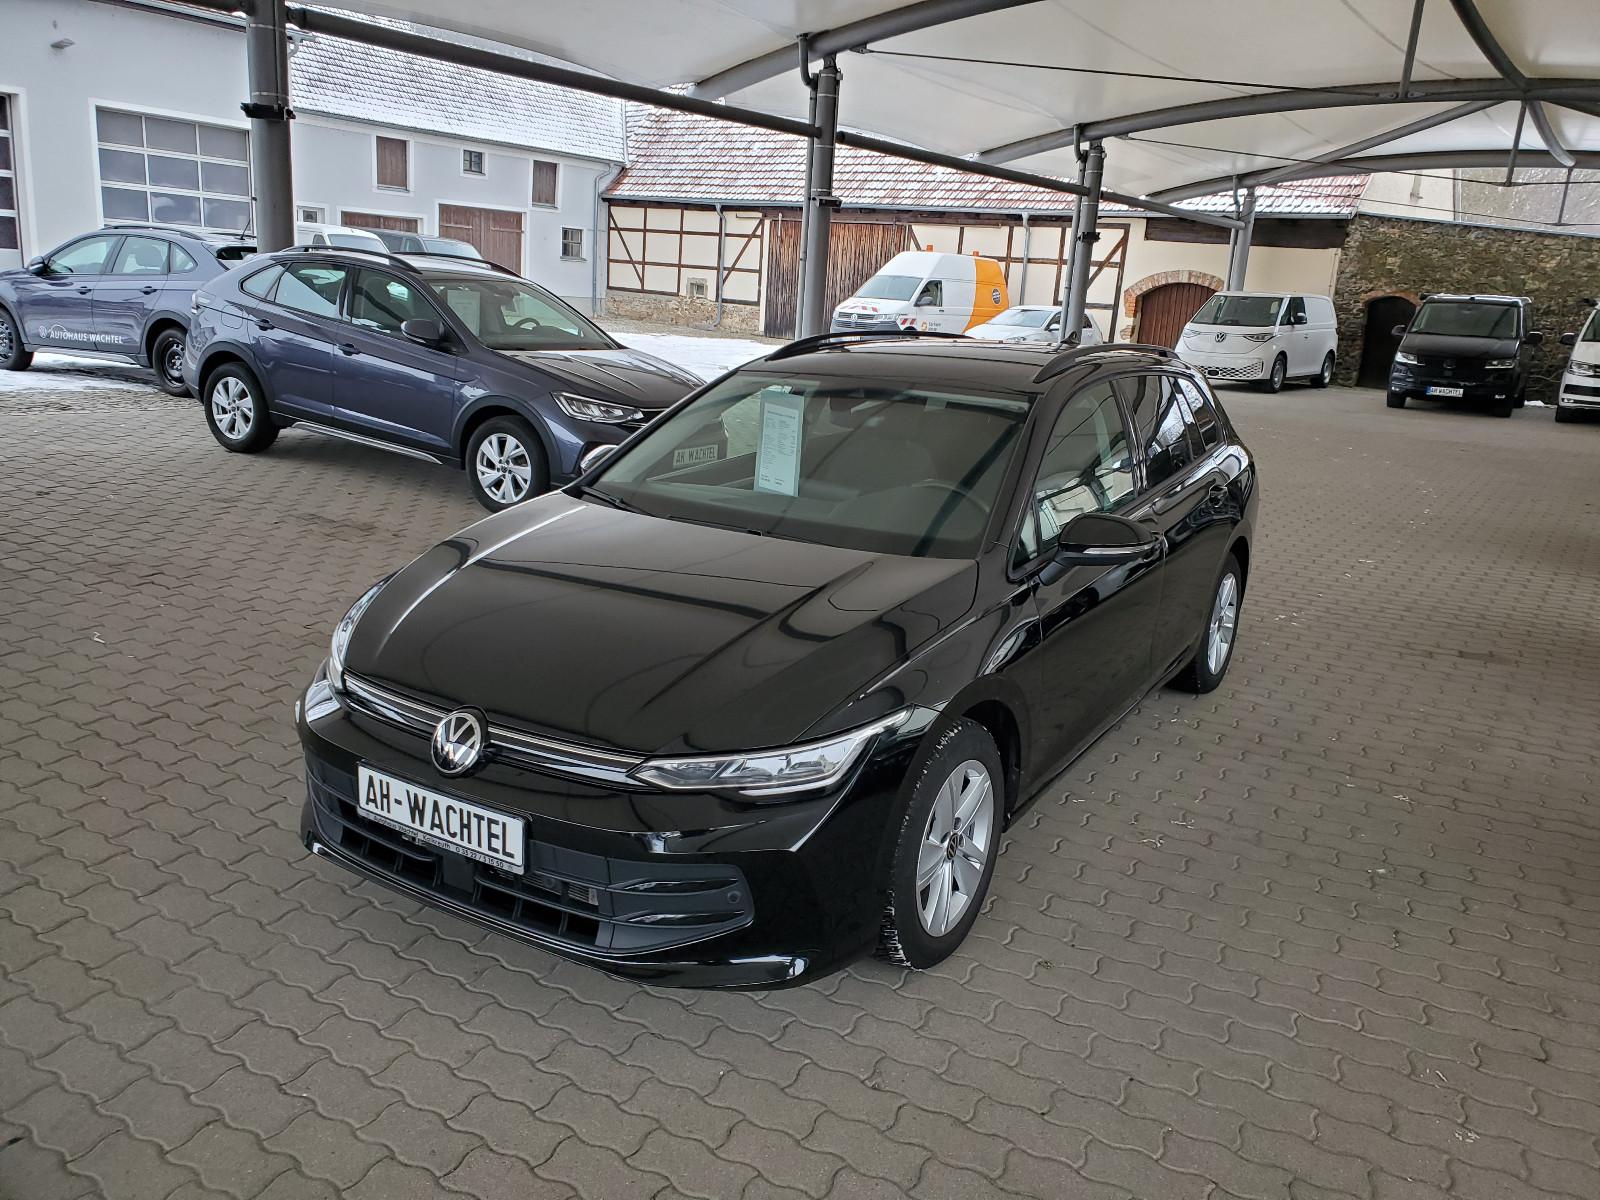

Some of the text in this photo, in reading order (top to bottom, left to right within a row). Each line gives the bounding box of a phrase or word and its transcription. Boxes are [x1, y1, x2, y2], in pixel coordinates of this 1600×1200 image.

[50, 330, 123, 344] AUTOHAUS WACHTEL
[688, 446, 716, 461] WACHTEL
[365, 774, 515, 860] AH-WACHTEL
[398, 824, 418, 838] Wachtel
